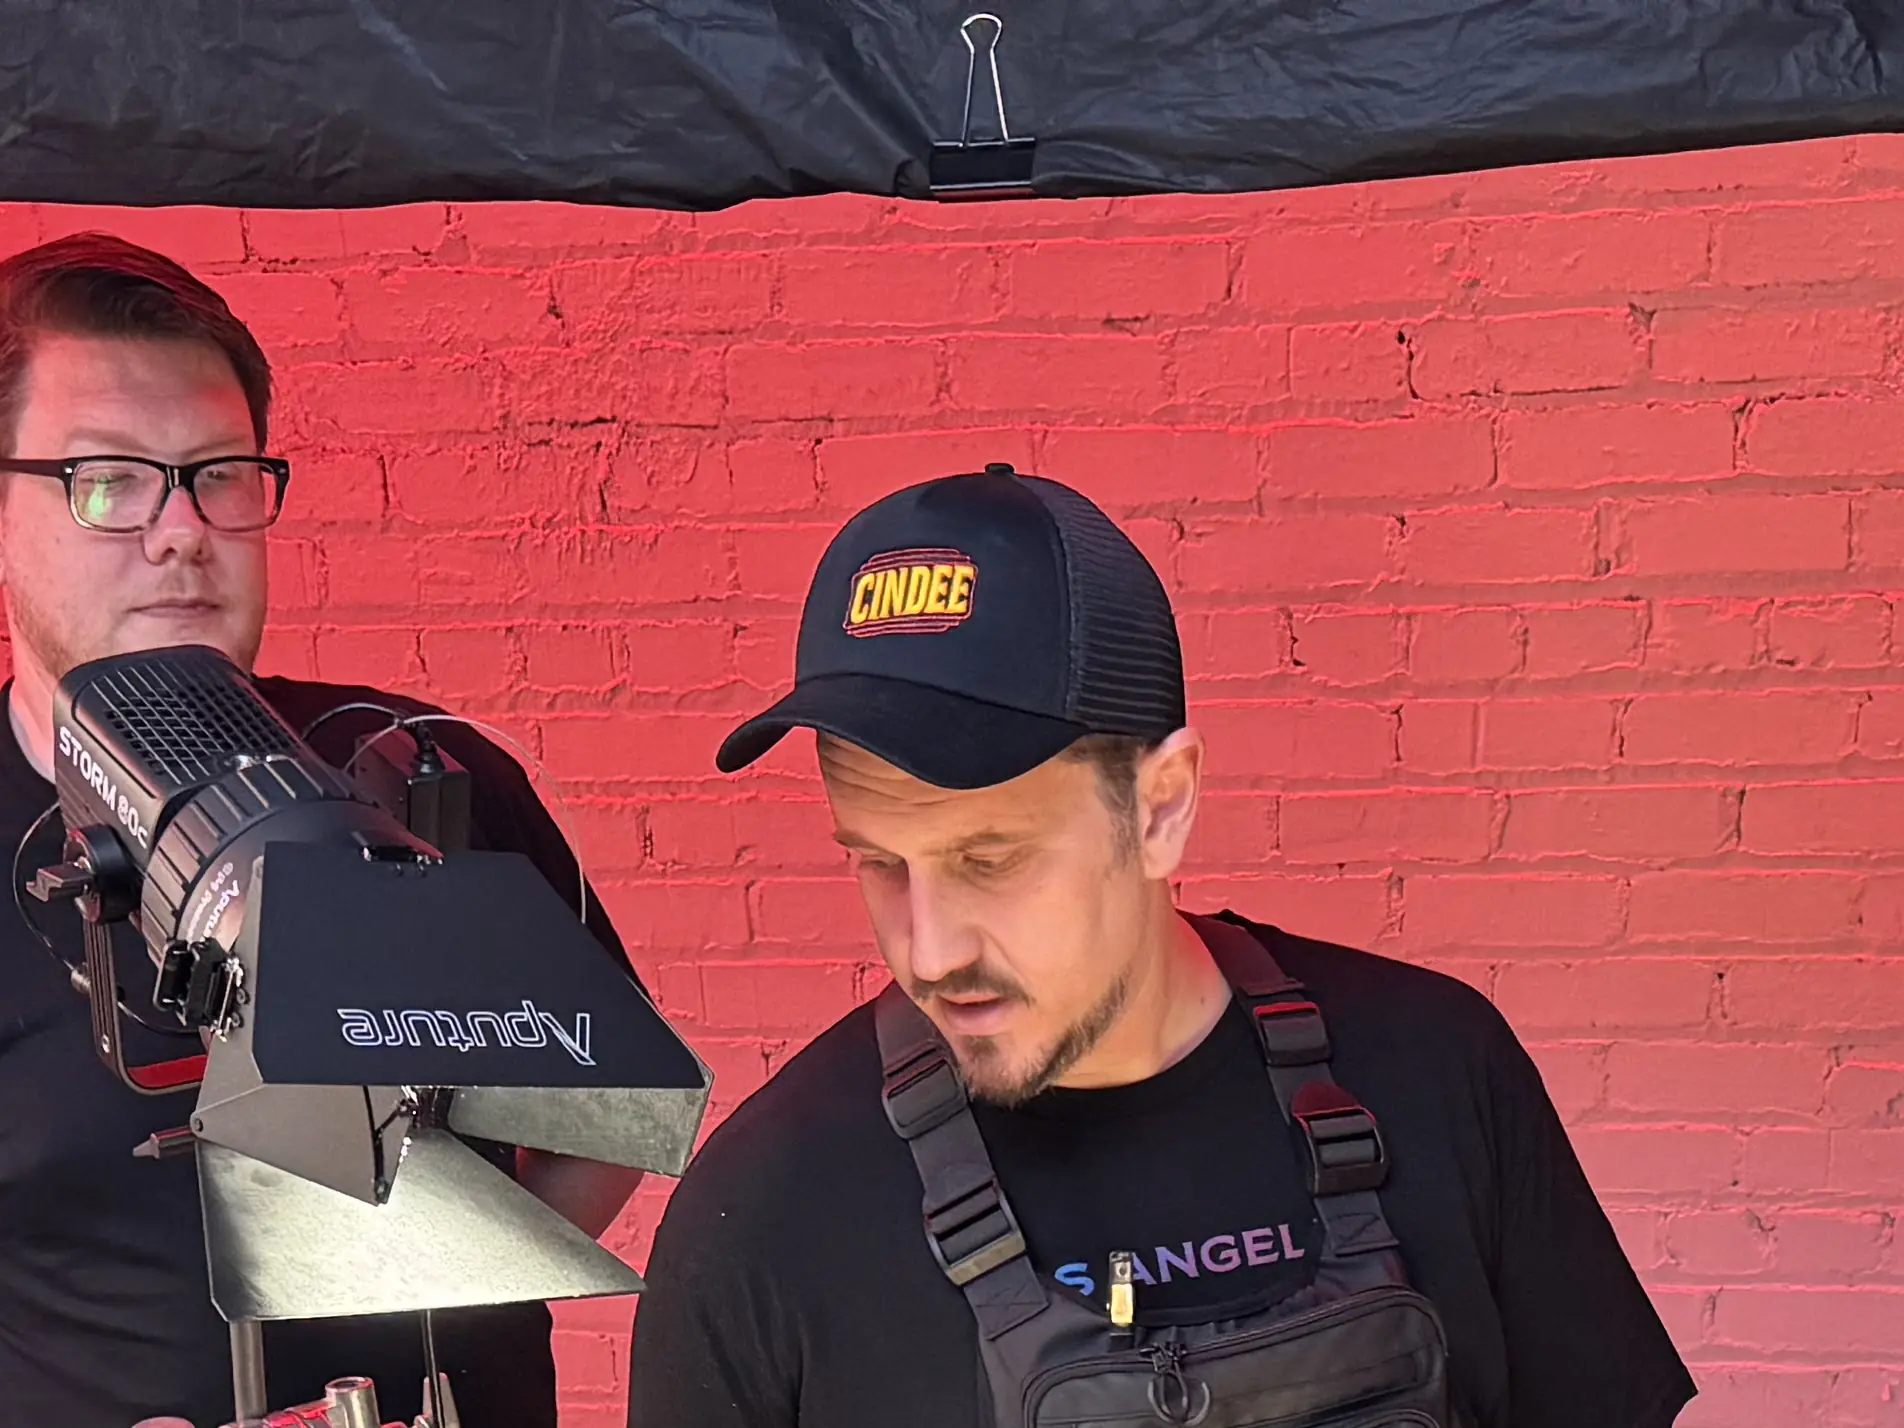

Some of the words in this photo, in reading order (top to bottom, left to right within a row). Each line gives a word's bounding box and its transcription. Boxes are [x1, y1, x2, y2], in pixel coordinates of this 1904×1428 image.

[850, 564, 975, 624] CINDEE
[59, 725, 117, 812] STORM
[337, 1000, 596, 1066] Aputure
